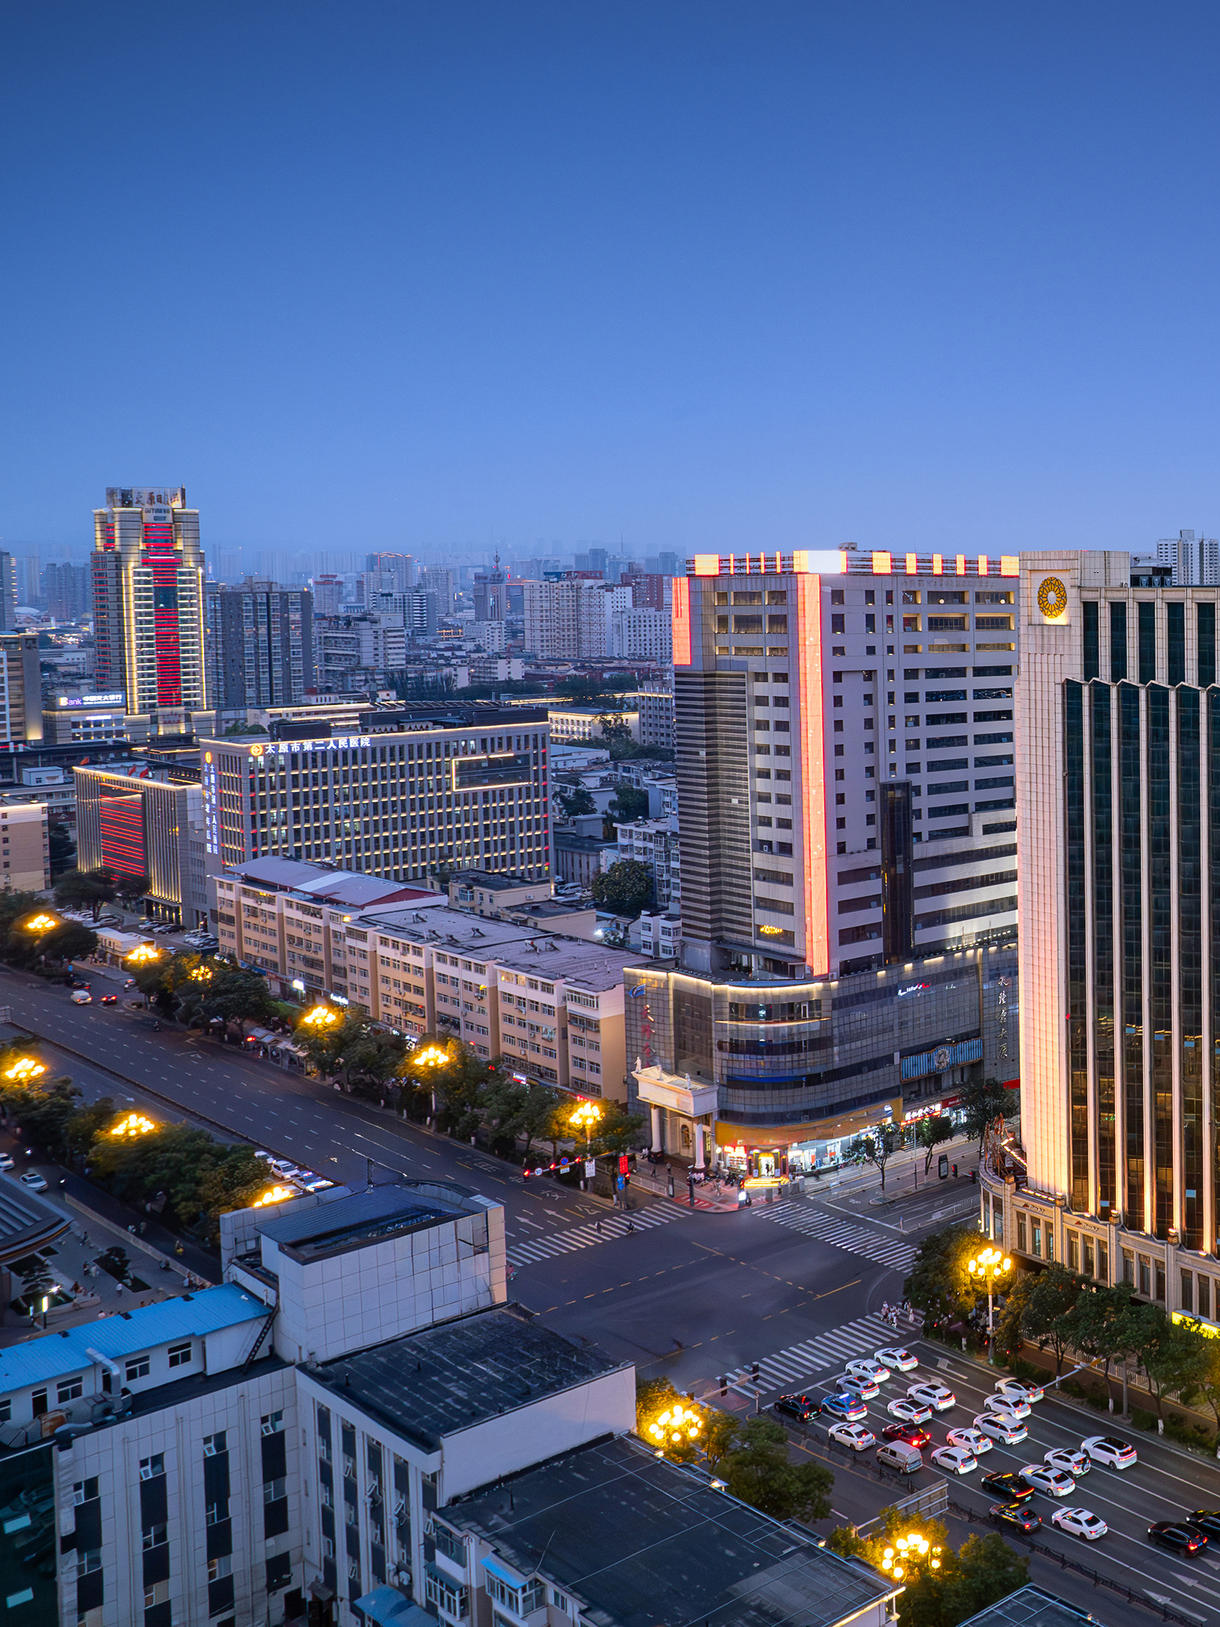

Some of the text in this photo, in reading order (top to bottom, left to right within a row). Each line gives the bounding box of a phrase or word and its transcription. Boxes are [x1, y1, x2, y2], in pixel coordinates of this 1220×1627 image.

[265, 736, 371, 755] 太原市第二人民医院
